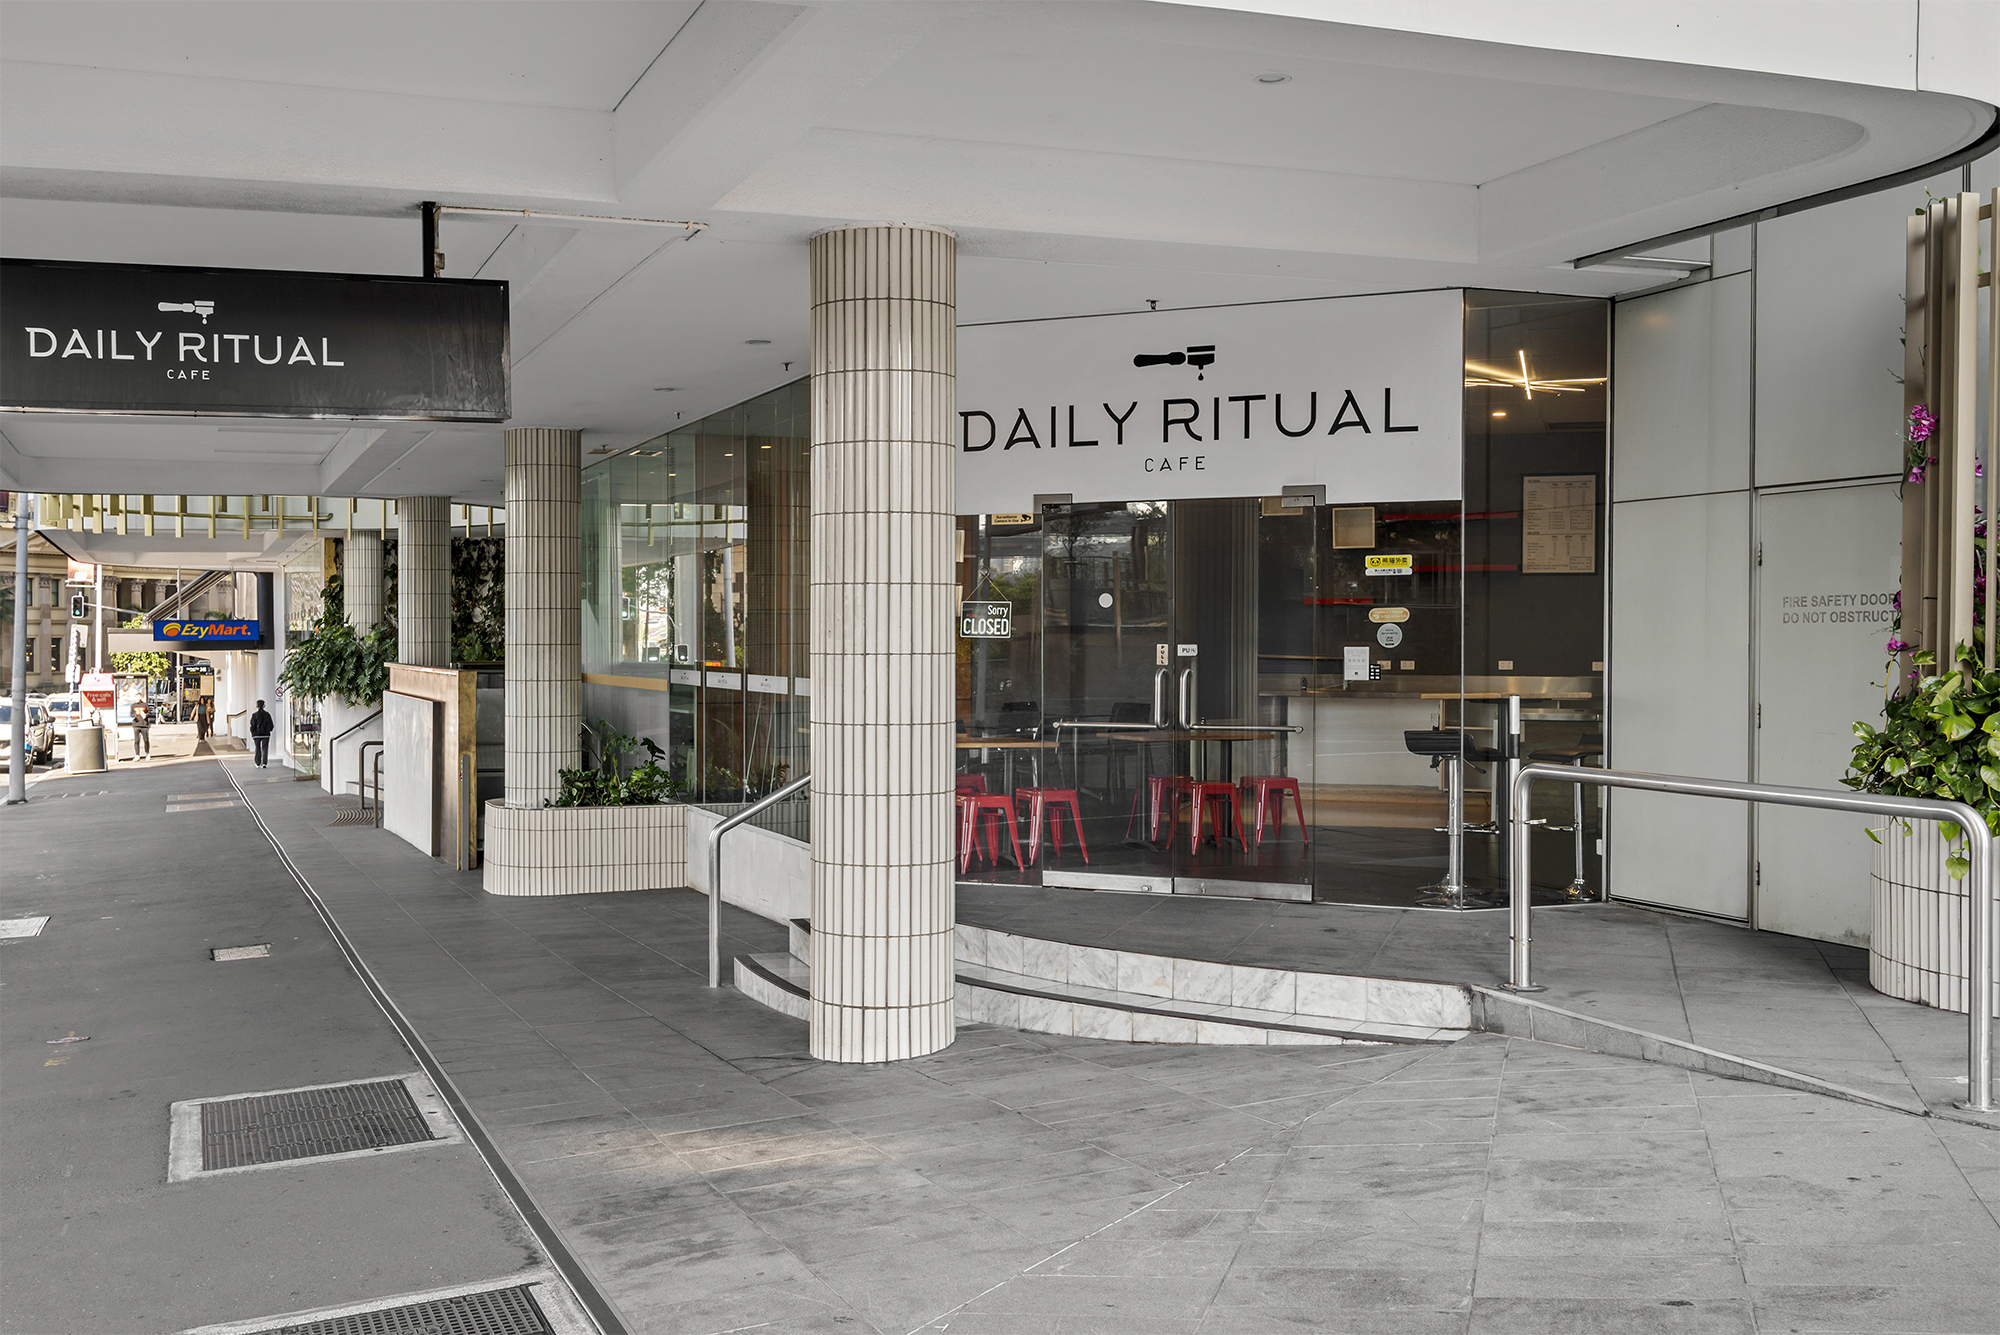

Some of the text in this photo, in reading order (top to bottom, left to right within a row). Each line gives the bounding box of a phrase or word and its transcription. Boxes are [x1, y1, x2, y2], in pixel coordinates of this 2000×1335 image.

[25, 326, 345, 367] DAILY RITUAL
[166, 369, 211, 381] CAFE
[958, 387, 1419, 452] DAILY RITUAL
[1144, 455, 1206, 473] CAFE
[1782, 596, 1807, 608] FIRE
[1811, 594, 1857, 607] SAFETY
[987, 604, 1008, 618] Sorry
[1782, 610, 1896, 624] DO NOT OBSTRUCT
[963, 618, 1009, 635] CLOSED
